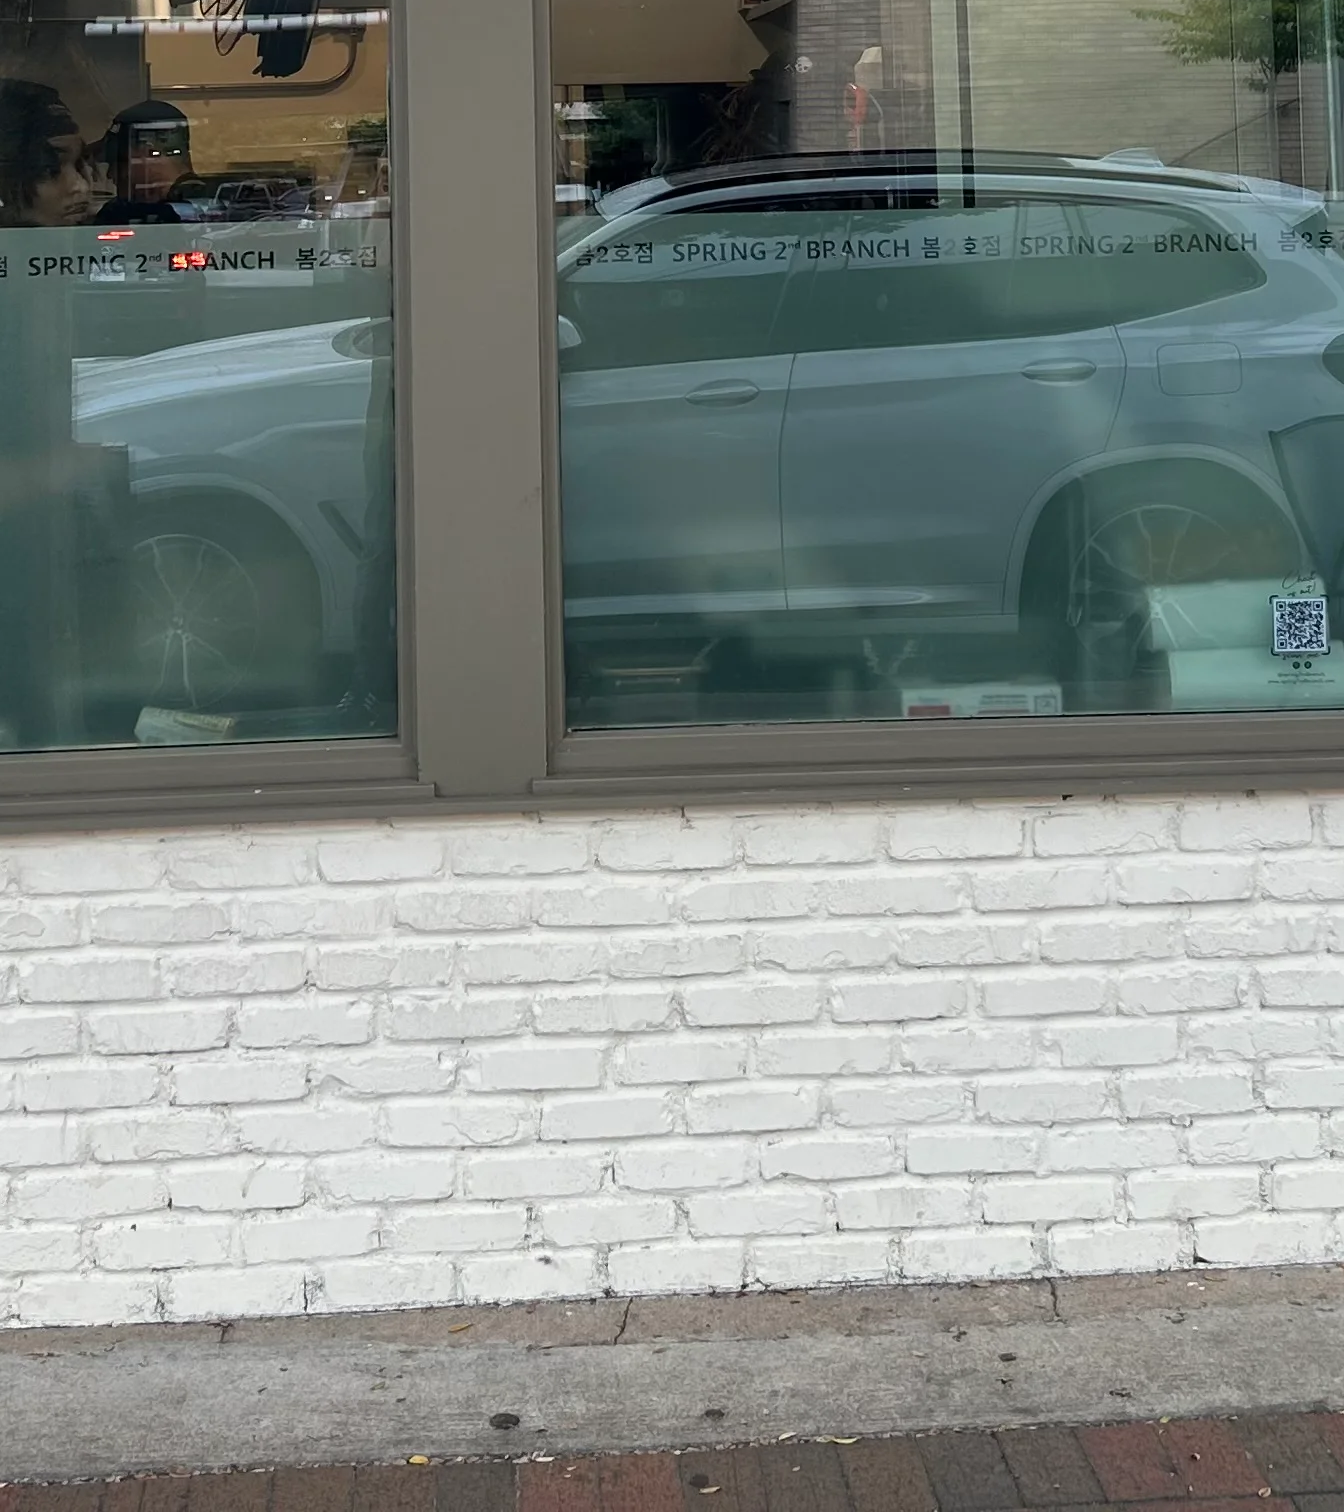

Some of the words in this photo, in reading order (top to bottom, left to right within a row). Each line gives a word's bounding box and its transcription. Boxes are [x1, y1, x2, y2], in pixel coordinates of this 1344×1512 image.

[672, 240, 766, 263] SPRING
[806, 238, 910, 261] BRANCH
[1019, 235, 1115, 256] SPRING
[1155, 231, 1258, 254] BRANCH
[27, 252, 126, 277] SPRING
[167, 249, 276, 273] BRANCH
